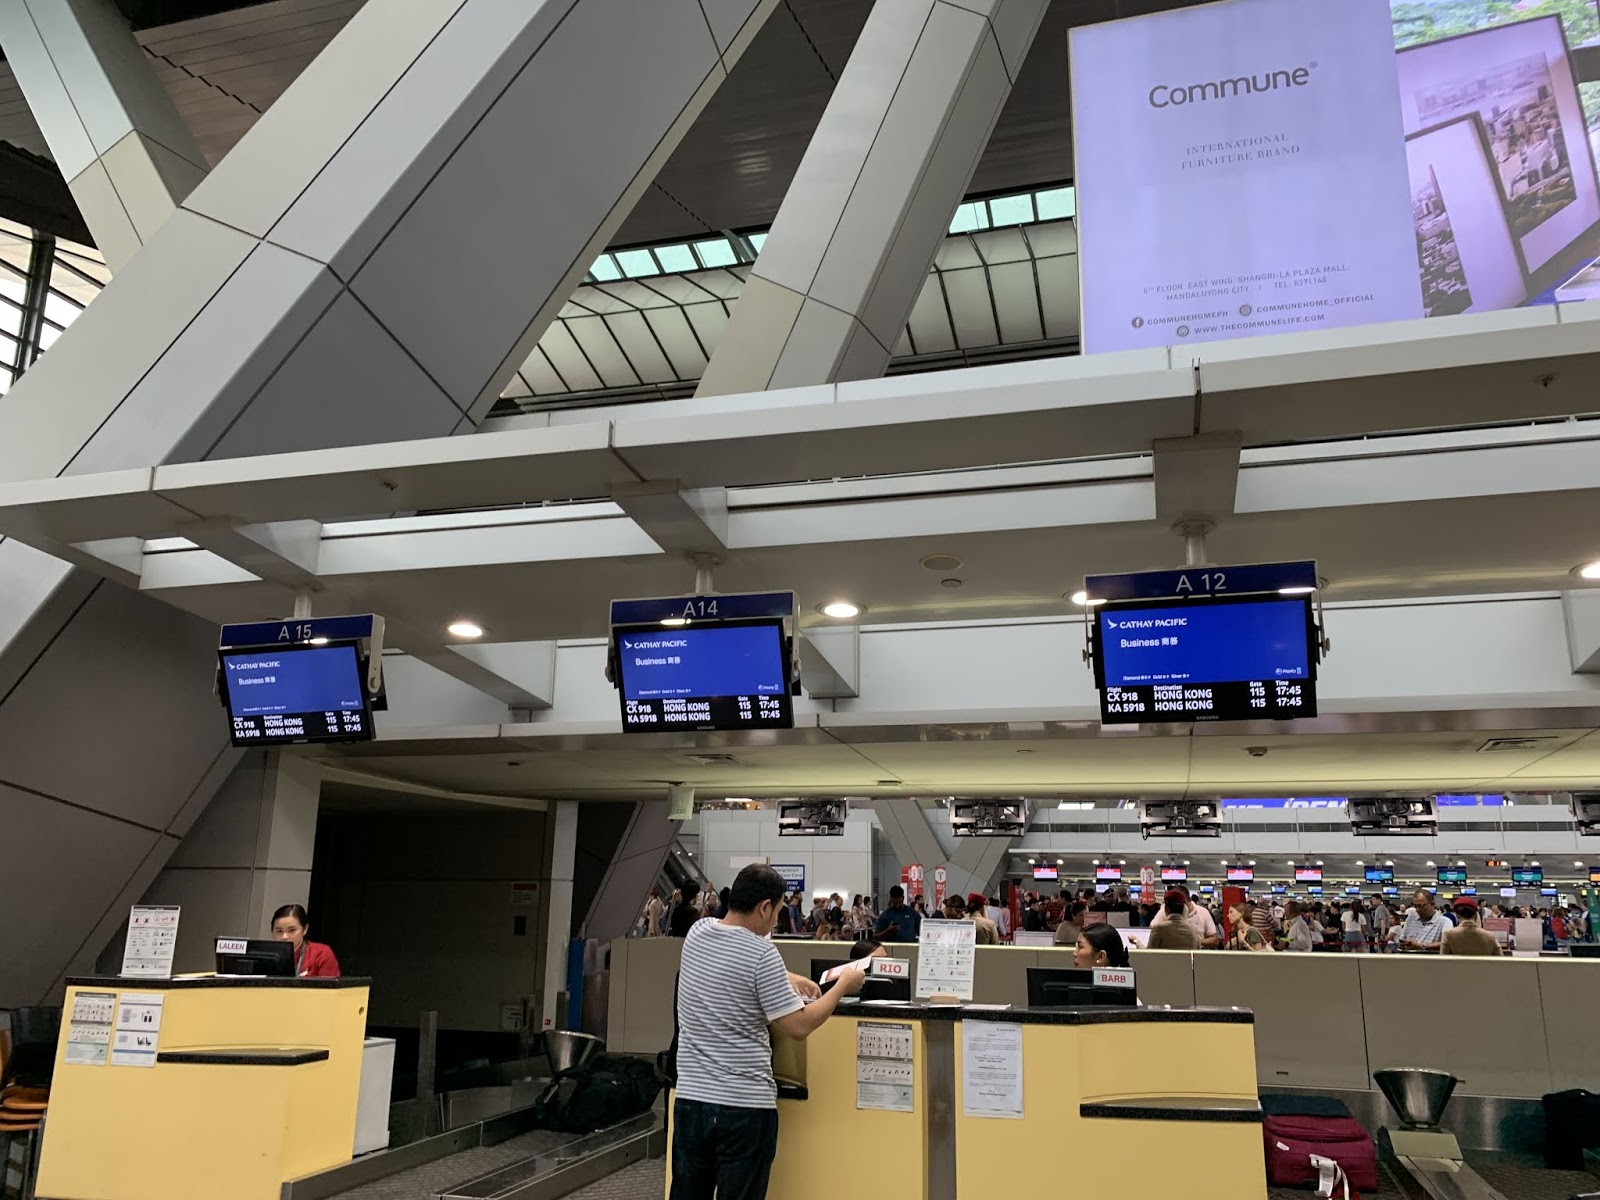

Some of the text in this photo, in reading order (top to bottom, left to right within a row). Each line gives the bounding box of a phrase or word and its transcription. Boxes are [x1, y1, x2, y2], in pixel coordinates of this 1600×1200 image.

[1187, 133, 1289, 156] INTERNATIONAL
[1181, 145, 1300, 170] FURNITURE BRAND
[1188, 280, 1208, 289] EAST
[1237, 271, 1291, 283] SHANGRI-LA
[1293, 267, 1320, 276] PLAZA
[1166, 288, 1230, 301] MANDALUYONG
[1231, 286, 1249, 294] CITY
[1256, 294, 1375, 313] COMMUNEHOME_OFFICIAL
[1147, 311, 1228, 325] COMMUNEHOMEPH
[1194, 314, 1325, 334] WWW.THECOMMUNELIFE.COM
[1175, 573, 1227, 593] A 12
[1119, 617, 1188, 629] CATHAY PACIFIC
[278, 624, 312, 640] A 15
[634, 639, 687, 649] CATHAY PACIFIC
[1120, 638, 1160, 648] Business
[236, 660, 281, 670] CATHAY PACIFIC
[635, 656, 667, 666] Business
[238, 677, 265, 686] Business
[1106, 685, 1302, 702] CX 918 HONG KONG 115 17:45
[626, 700, 779, 714] CX 918 HONG KONG 115 17:45
[1107, 696, 1302, 713] KA 5918 HONG KONG 115 17:45
[233, 715, 360, 730] CX 918 HONG KONG 115 17:45
[627, 710, 781, 723] KA 5918 HONG KONG 115 17:45
[235, 724, 362, 738] KA 5918 HONG KONG 115 17:45
[218, 942, 245, 951] LALEEN
[880, 963, 902, 974] RIO
[1101, 974, 1127, 984] BARB
